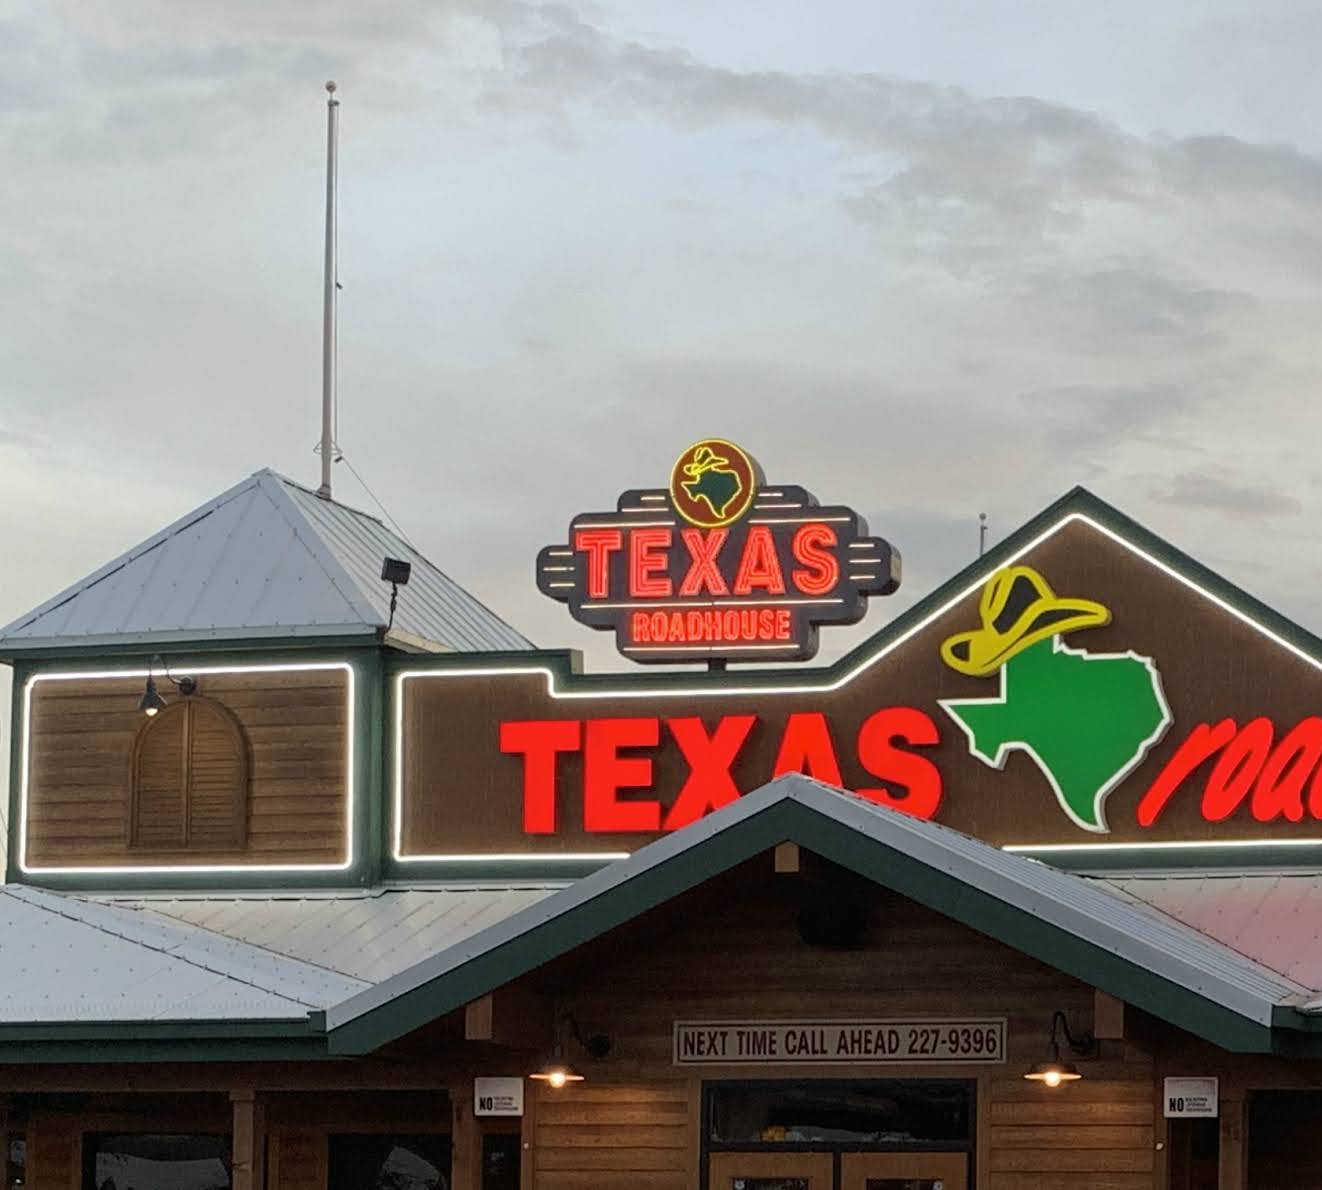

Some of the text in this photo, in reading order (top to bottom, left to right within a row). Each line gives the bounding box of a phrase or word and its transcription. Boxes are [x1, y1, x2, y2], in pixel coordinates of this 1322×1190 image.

[575, 522, 841, 599] TEXAS
[631, 609, 793, 642] ROADHOUSE
[500, 706, 943, 834] TEXAS
[684, 1028, 997, 1056] NEXT TIME CALL AHEAD 227-9396
[480, 1096, 493, 1111] NO
[1169, 1097, 1184, 1112] NO
